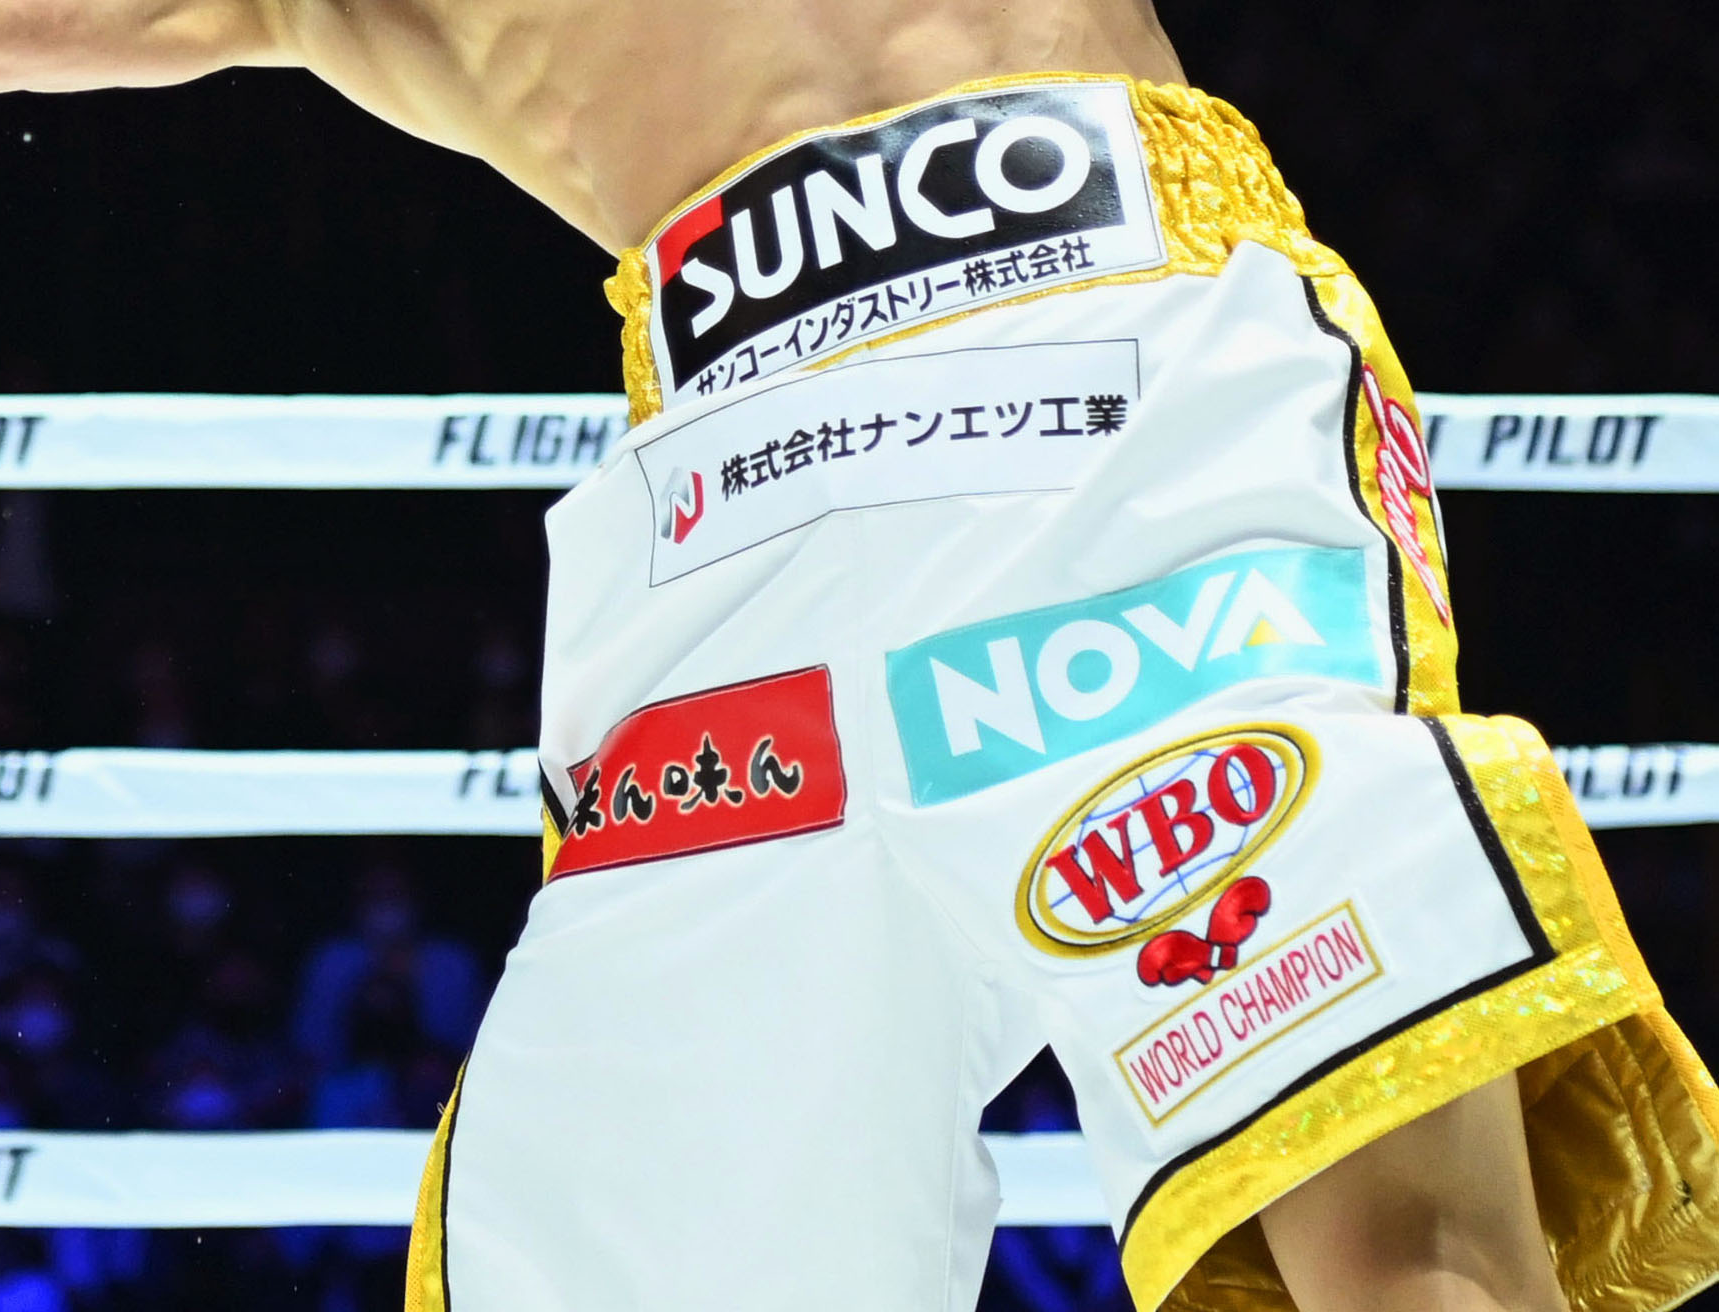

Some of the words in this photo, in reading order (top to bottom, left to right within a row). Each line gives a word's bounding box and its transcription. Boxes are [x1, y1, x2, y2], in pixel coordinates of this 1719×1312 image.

[657, 116, 1091, 338] SUNCO
[697, 236, 1094, 396] サンコーインダストリー株式会社
[434, 414, 630, 465] FLIGH
[721, 395, 1128, 501] 株式会社ナンエツ工業
[1483, 415, 1661, 466] PILOT
[928, 567, 1327, 757] NOVA
[1045, 742, 1277, 925] WBO
[1129, 1011, 1223, 1104] WORLD
[1219, 920, 1365, 1041] CHAMPION
